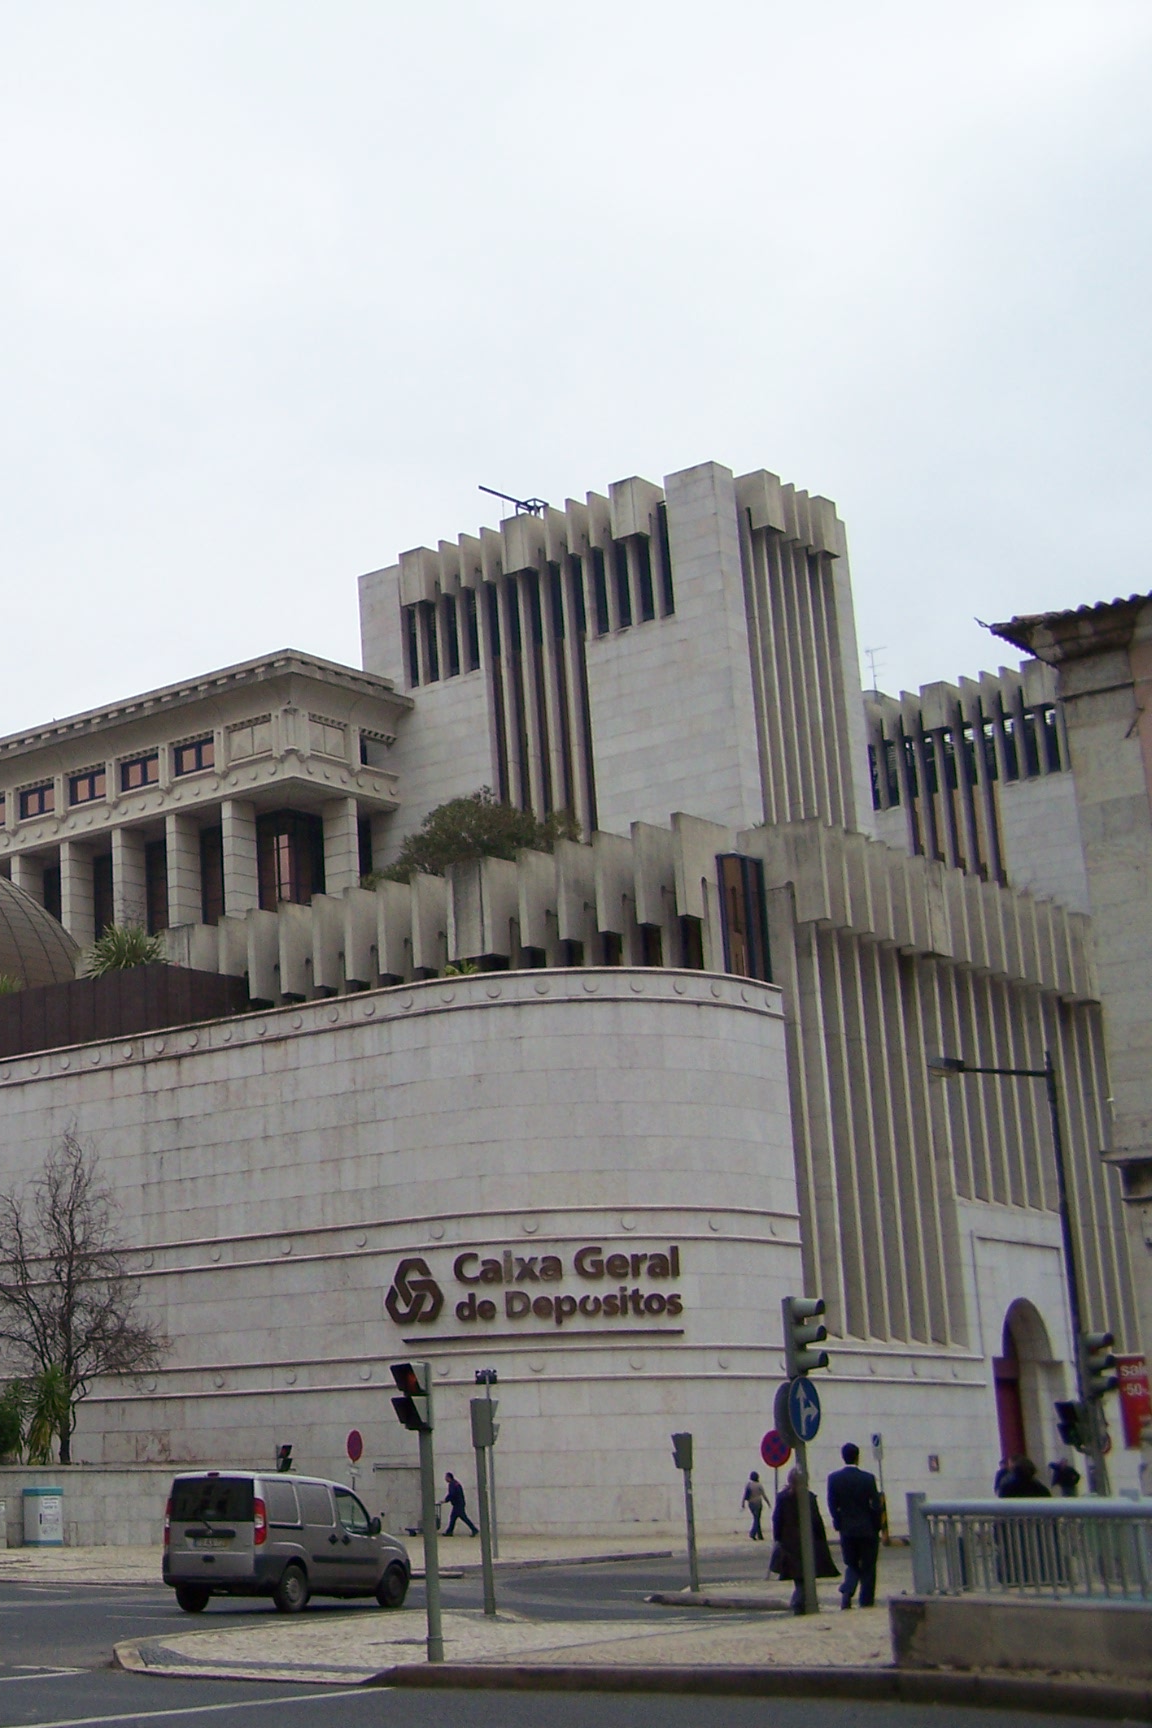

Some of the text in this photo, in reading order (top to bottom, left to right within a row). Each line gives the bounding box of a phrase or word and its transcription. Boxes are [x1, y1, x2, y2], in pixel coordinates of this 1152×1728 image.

[453, 1245, 680, 1284] Caixa Geral
[455, 1286, 684, 1325] de Depositos
